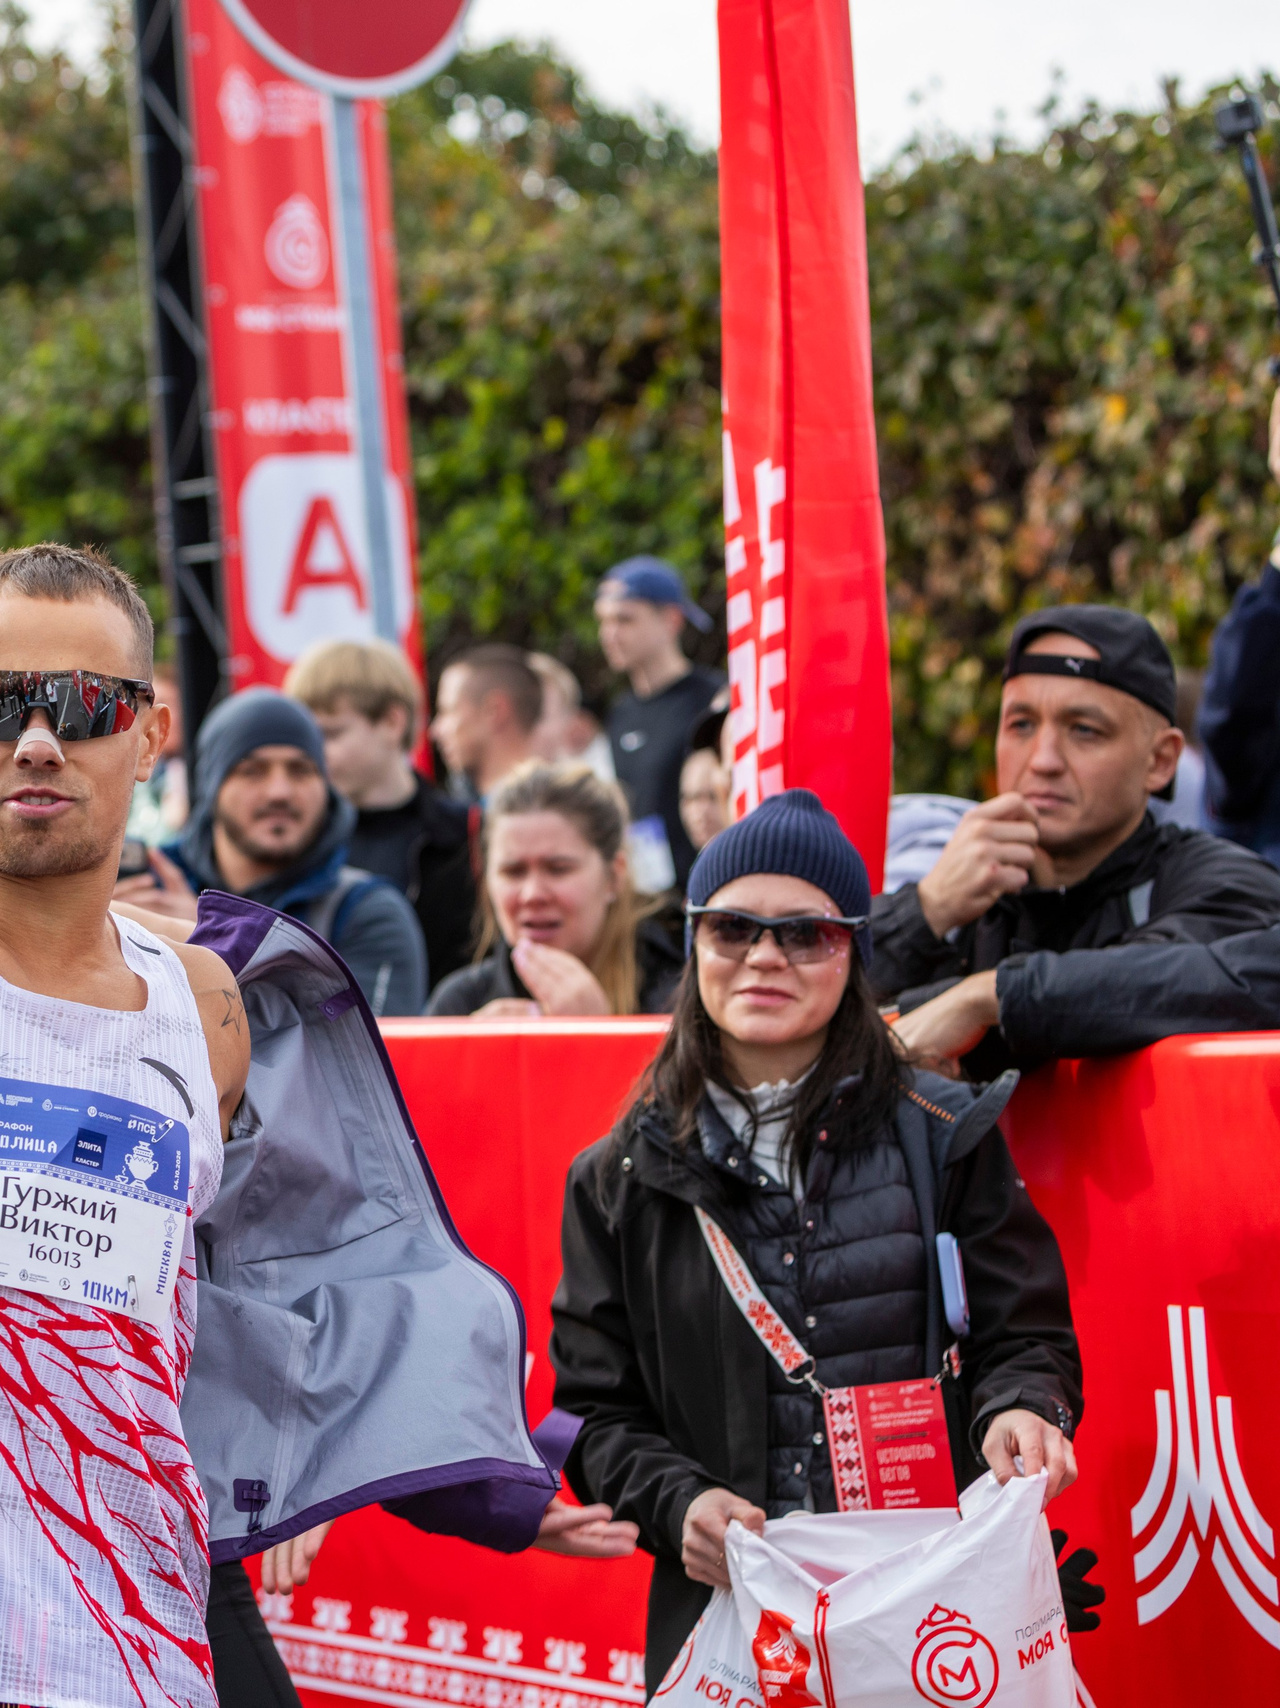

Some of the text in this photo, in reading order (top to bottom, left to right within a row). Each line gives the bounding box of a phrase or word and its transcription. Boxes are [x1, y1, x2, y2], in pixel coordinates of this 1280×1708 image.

[281, 496, 368, 615] А
[77, 1140, 102, 1154] ЭЛИТА
[137, 1121, 156, 1135] ПСБ
[75, 1156, 99, 1167] КЛАСТЕР
[2, 1176, 117, 1224] Гуржий
[0, 1204, 112, 1258] Виктор
[28, 1243, 81, 1269] 16013
[155, 1240, 173, 1295] МОСКВА
[1017, 1630, 1055, 1671] МОЯ
